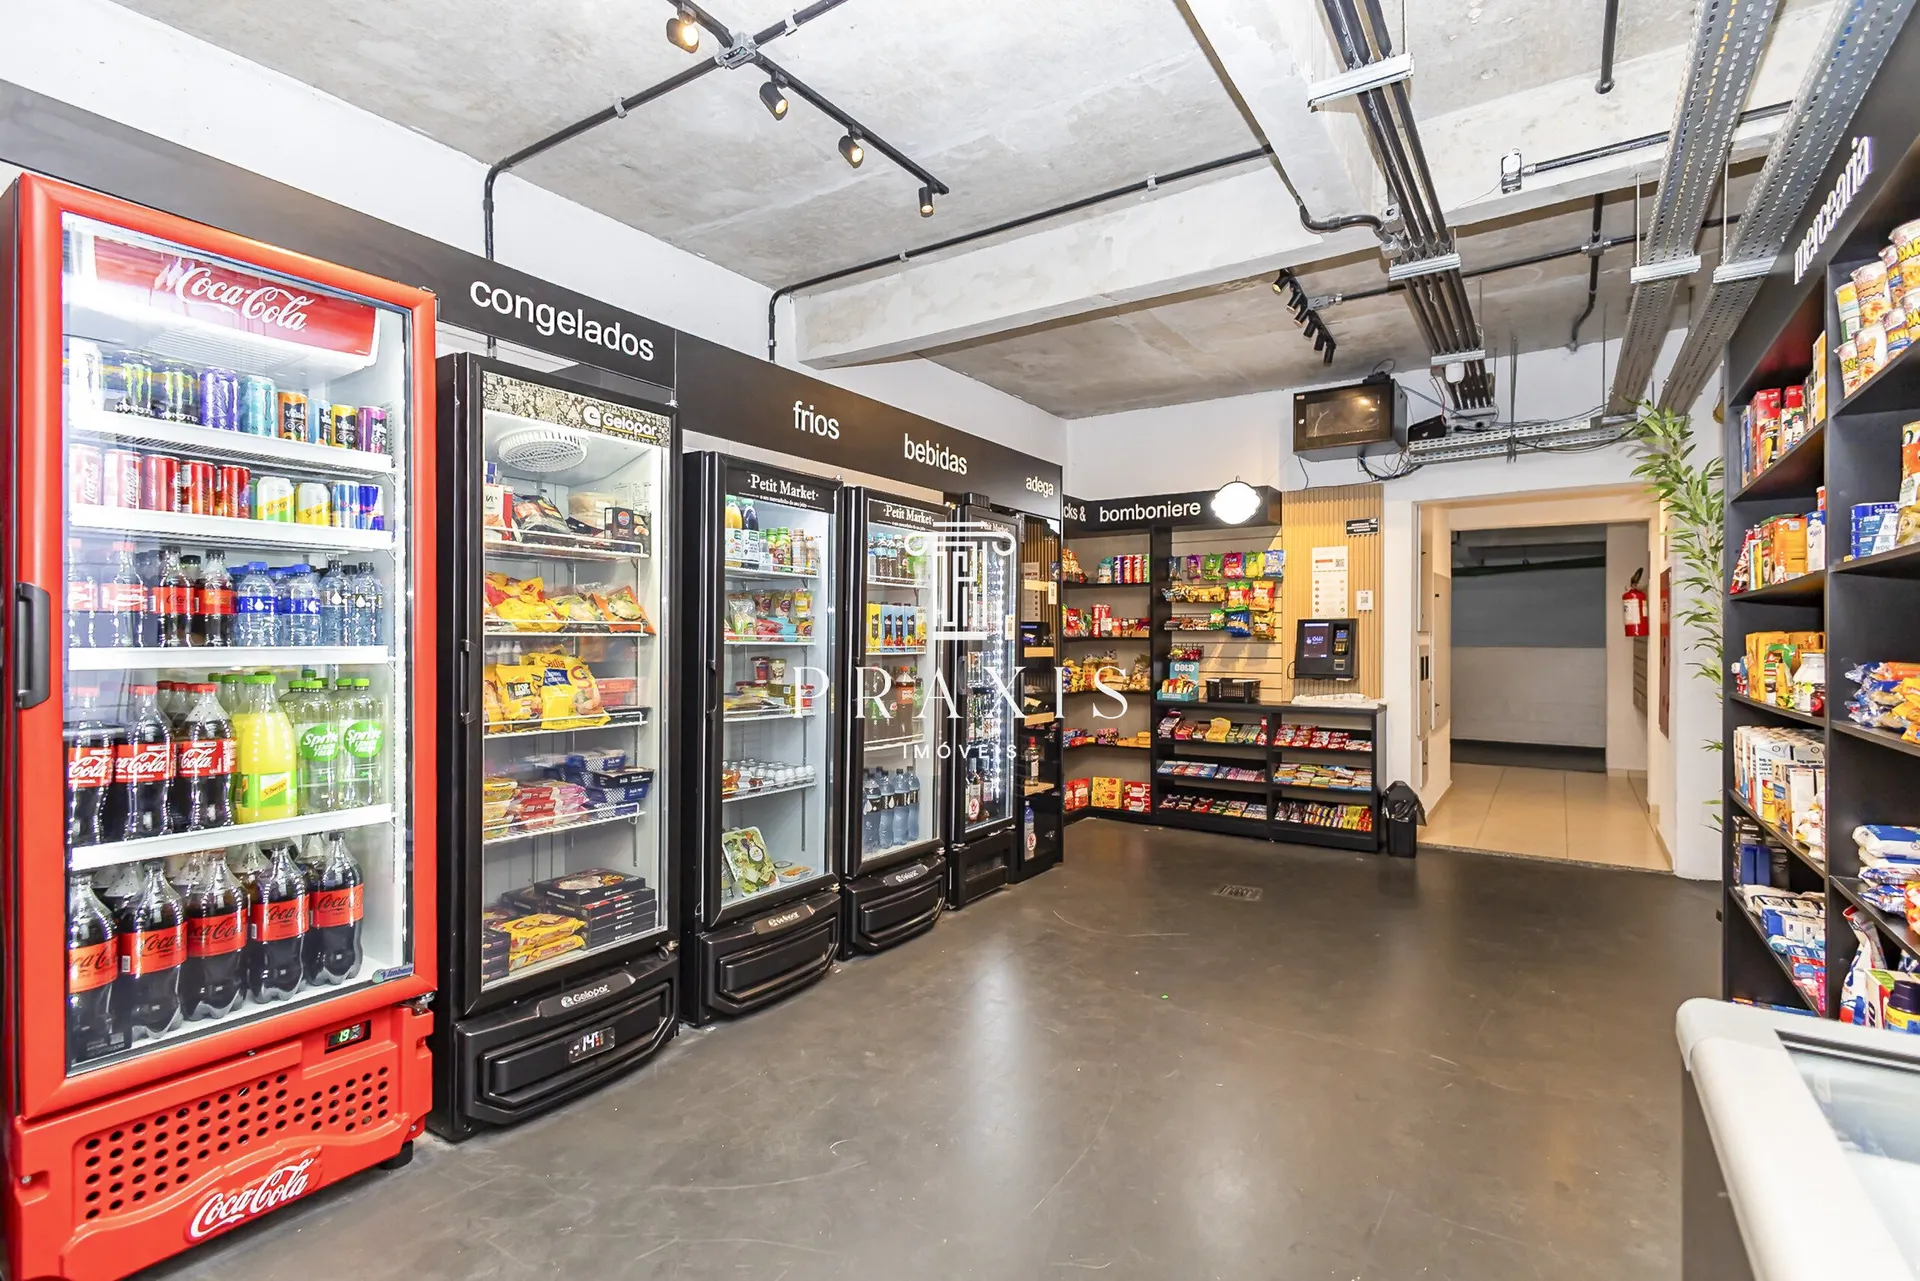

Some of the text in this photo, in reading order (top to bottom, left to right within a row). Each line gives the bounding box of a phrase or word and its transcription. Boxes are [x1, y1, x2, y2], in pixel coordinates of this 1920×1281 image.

[1793, 136, 1872, 286] mercearia
[174, 266, 316, 332] Coca-Cola
[469, 280, 656, 362] congelados
[602, 413, 658, 438] Gelopar
[792, 400, 841, 440] frios
[903, 433, 968, 475] bebidas
[750, 473, 778, 494] Petit
[780, 479, 816, 501] Market
[1025, 475, 1054, 499] adega
[885, 503, 933, 525] Petit Market
[1079, 505, 1087, 522] &
[1099, 500, 1202, 523] bomboniere
[572, 984, 609, 1003] Gelopar
[190, 1158, 315, 1238] Coca-Cola
